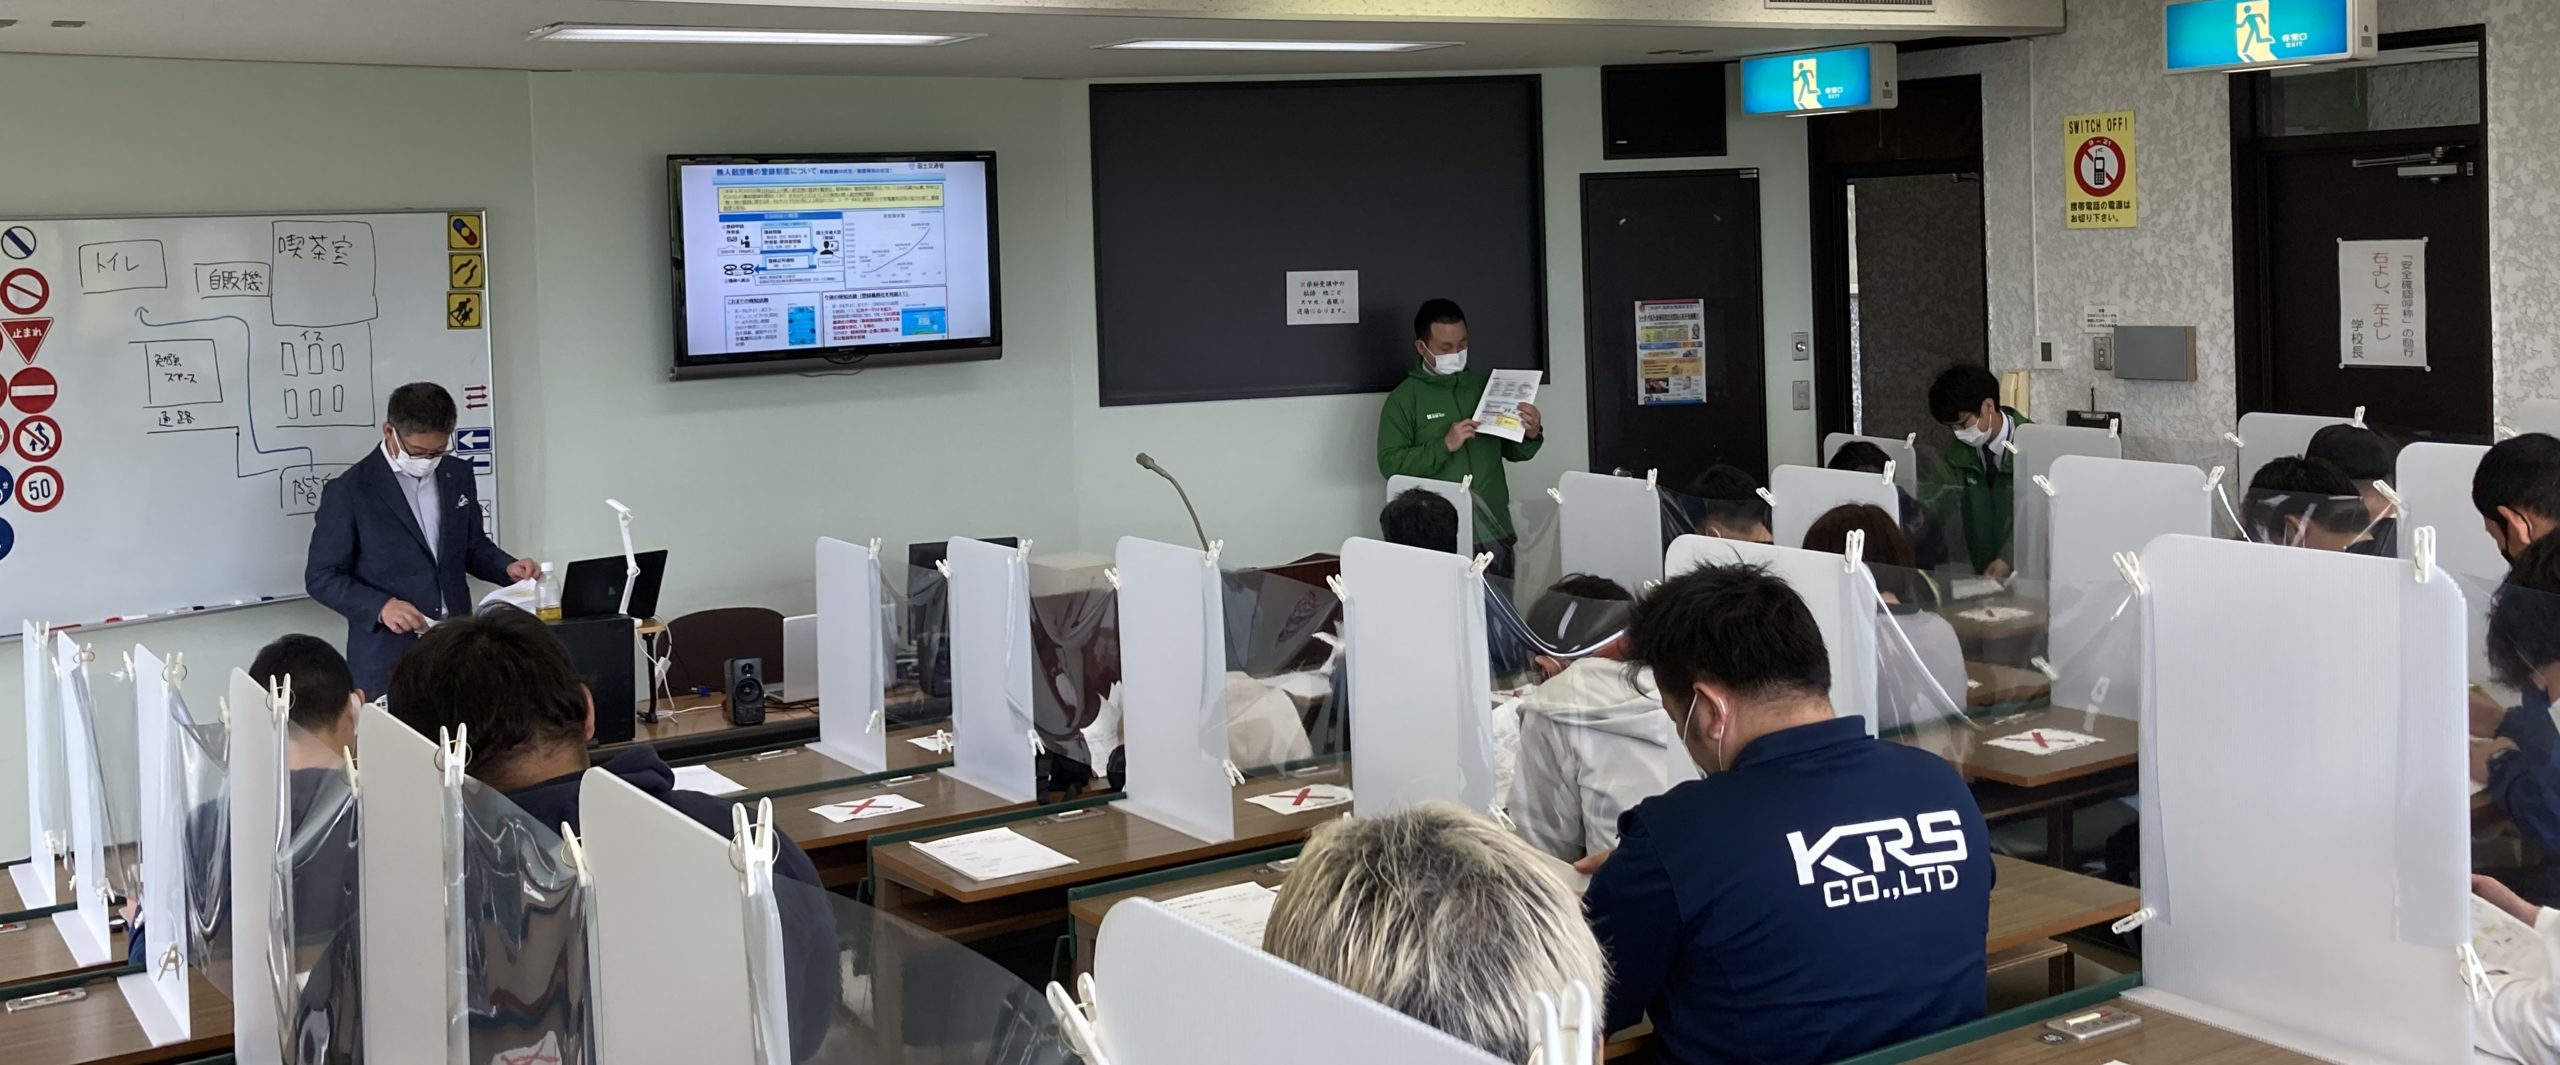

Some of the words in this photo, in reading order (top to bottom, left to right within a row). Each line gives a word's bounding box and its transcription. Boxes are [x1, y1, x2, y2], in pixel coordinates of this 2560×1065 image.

[2069, 119, 2101, 134] SWITCH
[2107, 117, 2128, 131] OFF!
[2071, 201, 2131, 211] 携帯電話の電源は
[2070, 213, 2119, 223] お切り下さい。
[278, 234, 353, 266] 喫茶室
[96, 251, 140, 273] トイレ
[209, 269, 264, 292] 自販機
[12, 328, 43, 339] 止まれ
[299, 330, 324, 342] イス
[2350, 319, 2365, 360] 学校長
[158, 410, 195, 427] 通路
[28, 478, 51, 501] 50
[292, 472, 332, 506] 階
[1785, 809, 1968, 886] KRS
[1822, 864, 1959, 908] CO.,LTD
